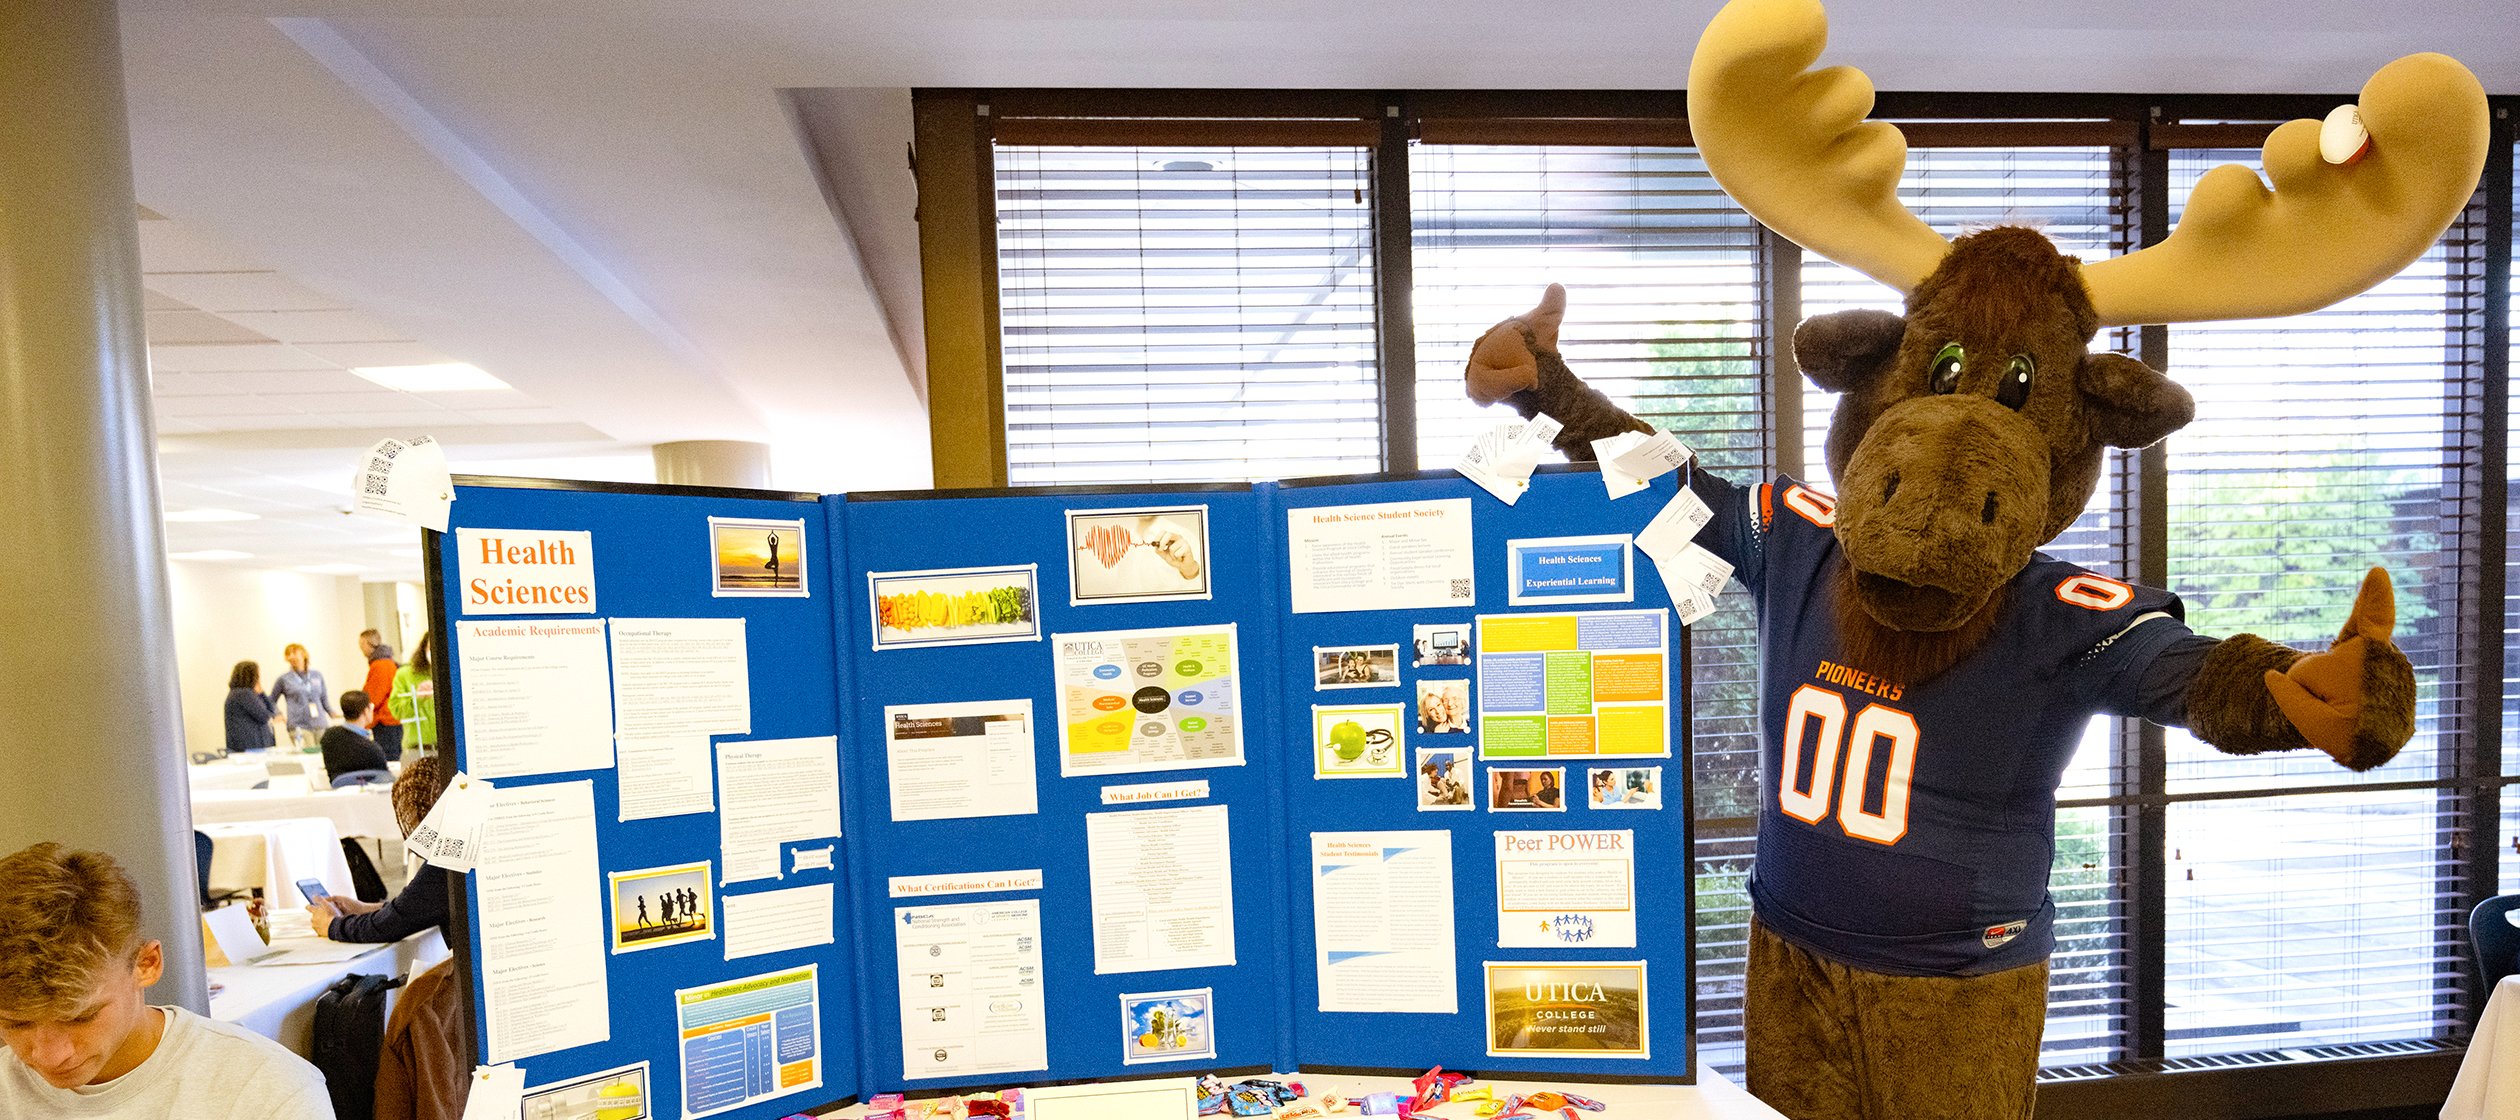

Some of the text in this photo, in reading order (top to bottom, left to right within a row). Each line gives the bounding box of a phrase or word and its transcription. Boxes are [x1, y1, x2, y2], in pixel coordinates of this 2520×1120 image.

[1313, 509, 1445, 524] Health Science Student Society
[480, 538, 576, 565] Health
[1538, 554, 1602, 565] Health Sciences
[1526, 576, 1616, 589] Experiential Learning
[471, 578, 589, 605] Sciences
[473, 626, 601, 638] Academic Requirements
[1074, 641, 1103, 651] UTICA
[1815, 660, 1905, 701] PIONEERS
[895, 720, 942, 730] Health Sciences
[1778, 683, 1921, 846] 00
[1110, 789, 1202, 801] What Job Can I Get?
[1504, 833, 1625, 851] Peer POWER
[897, 878, 1036, 893] What Certifications Can I Get?
[685, 993, 704, 1002] Minor
[711, 986, 742, 998] Healthcare
[743, 980, 769, 991] Advocacy
[769, 977, 781, 985] and
[781, 971, 810, 984] Navigation
[1525, 982, 1607, 1002] UTICA
[1536, 1011, 1595, 1019] COLLEGE
[1527, 1024, 1606, 1033] Never stand still
